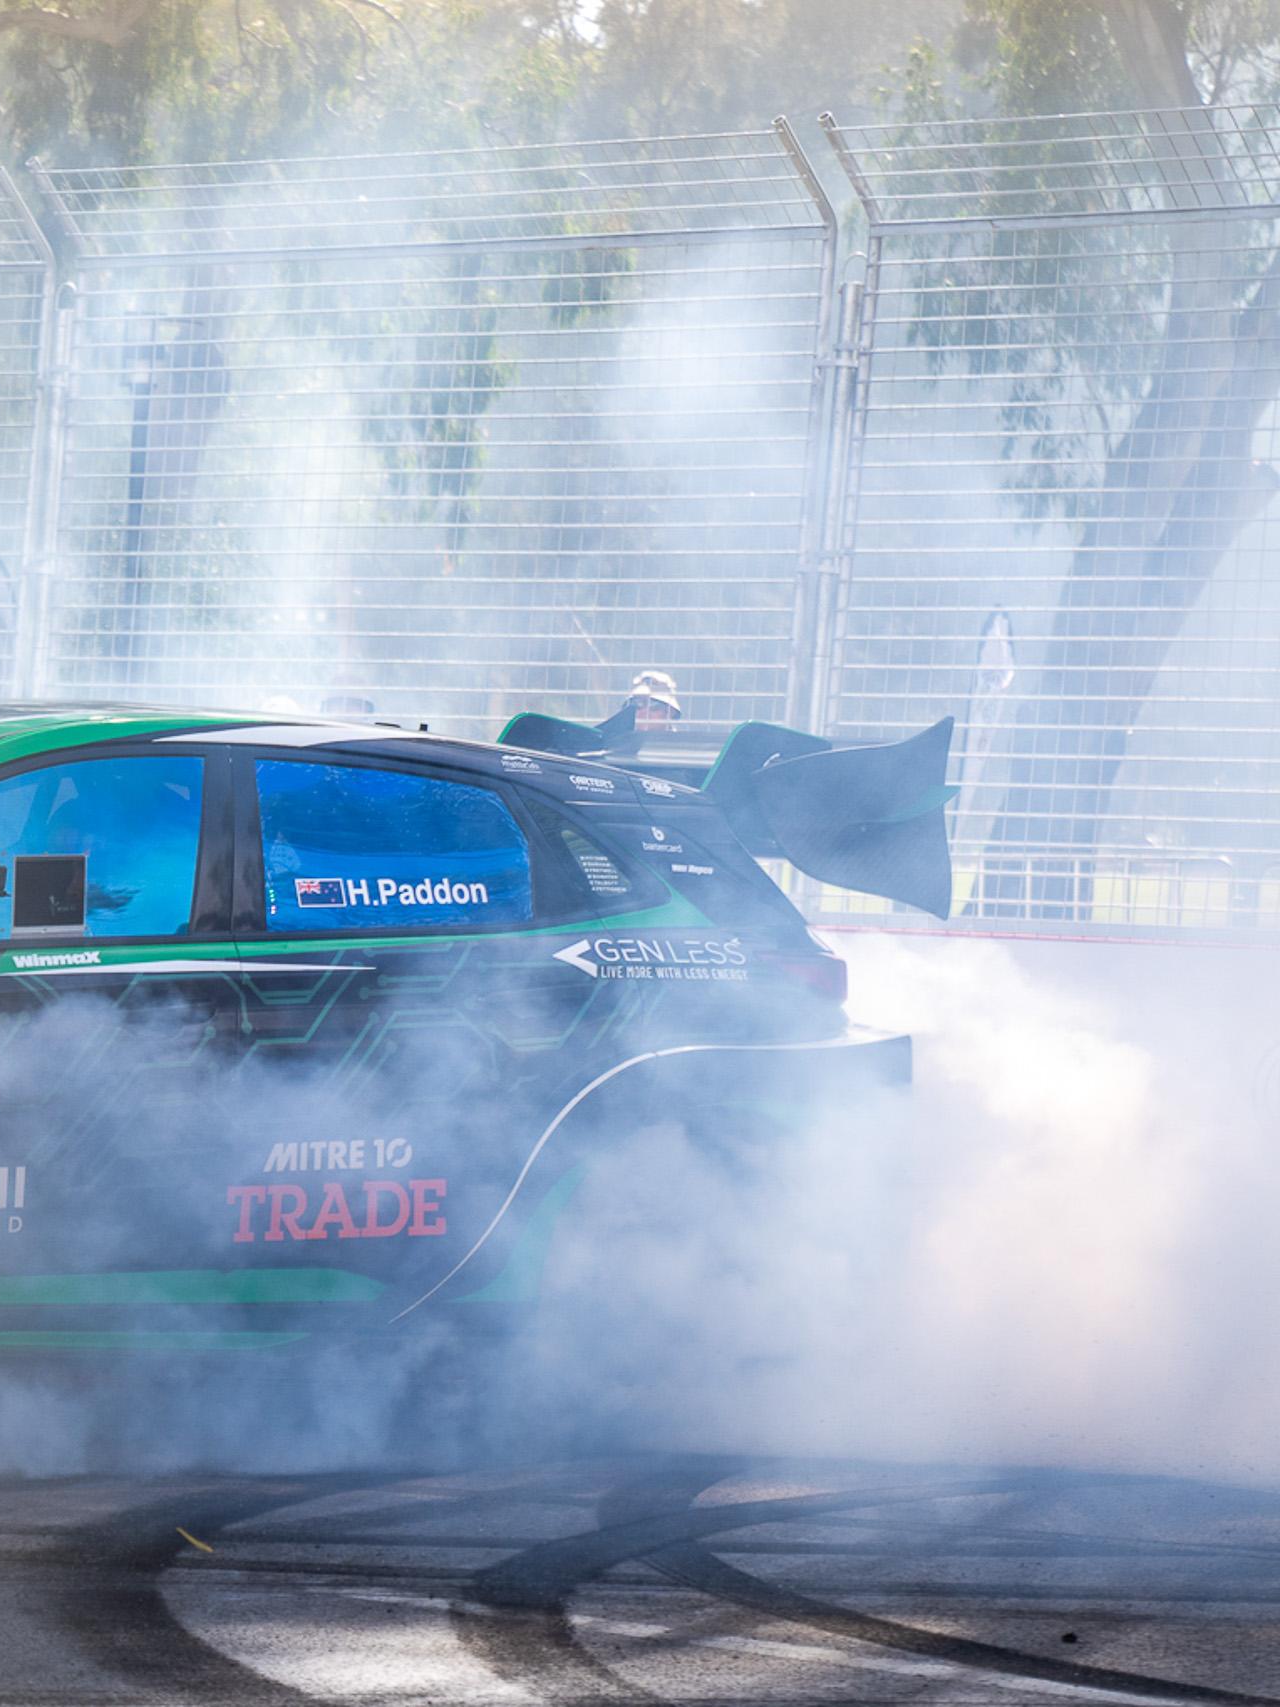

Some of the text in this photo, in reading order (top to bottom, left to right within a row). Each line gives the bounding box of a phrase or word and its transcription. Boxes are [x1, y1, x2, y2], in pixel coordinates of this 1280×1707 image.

[346, 877, 488, 906] H.Paddon
[601, 966, 624, 979] LIVE
[626, 966, 653, 979] MORE
[655, 967, 682, 980] WITH
[684, 968, 710, 980] LESS
[263, 1138, 413, 1172] MITRE 10
[226, 1178, 448, 1243] TRADE
